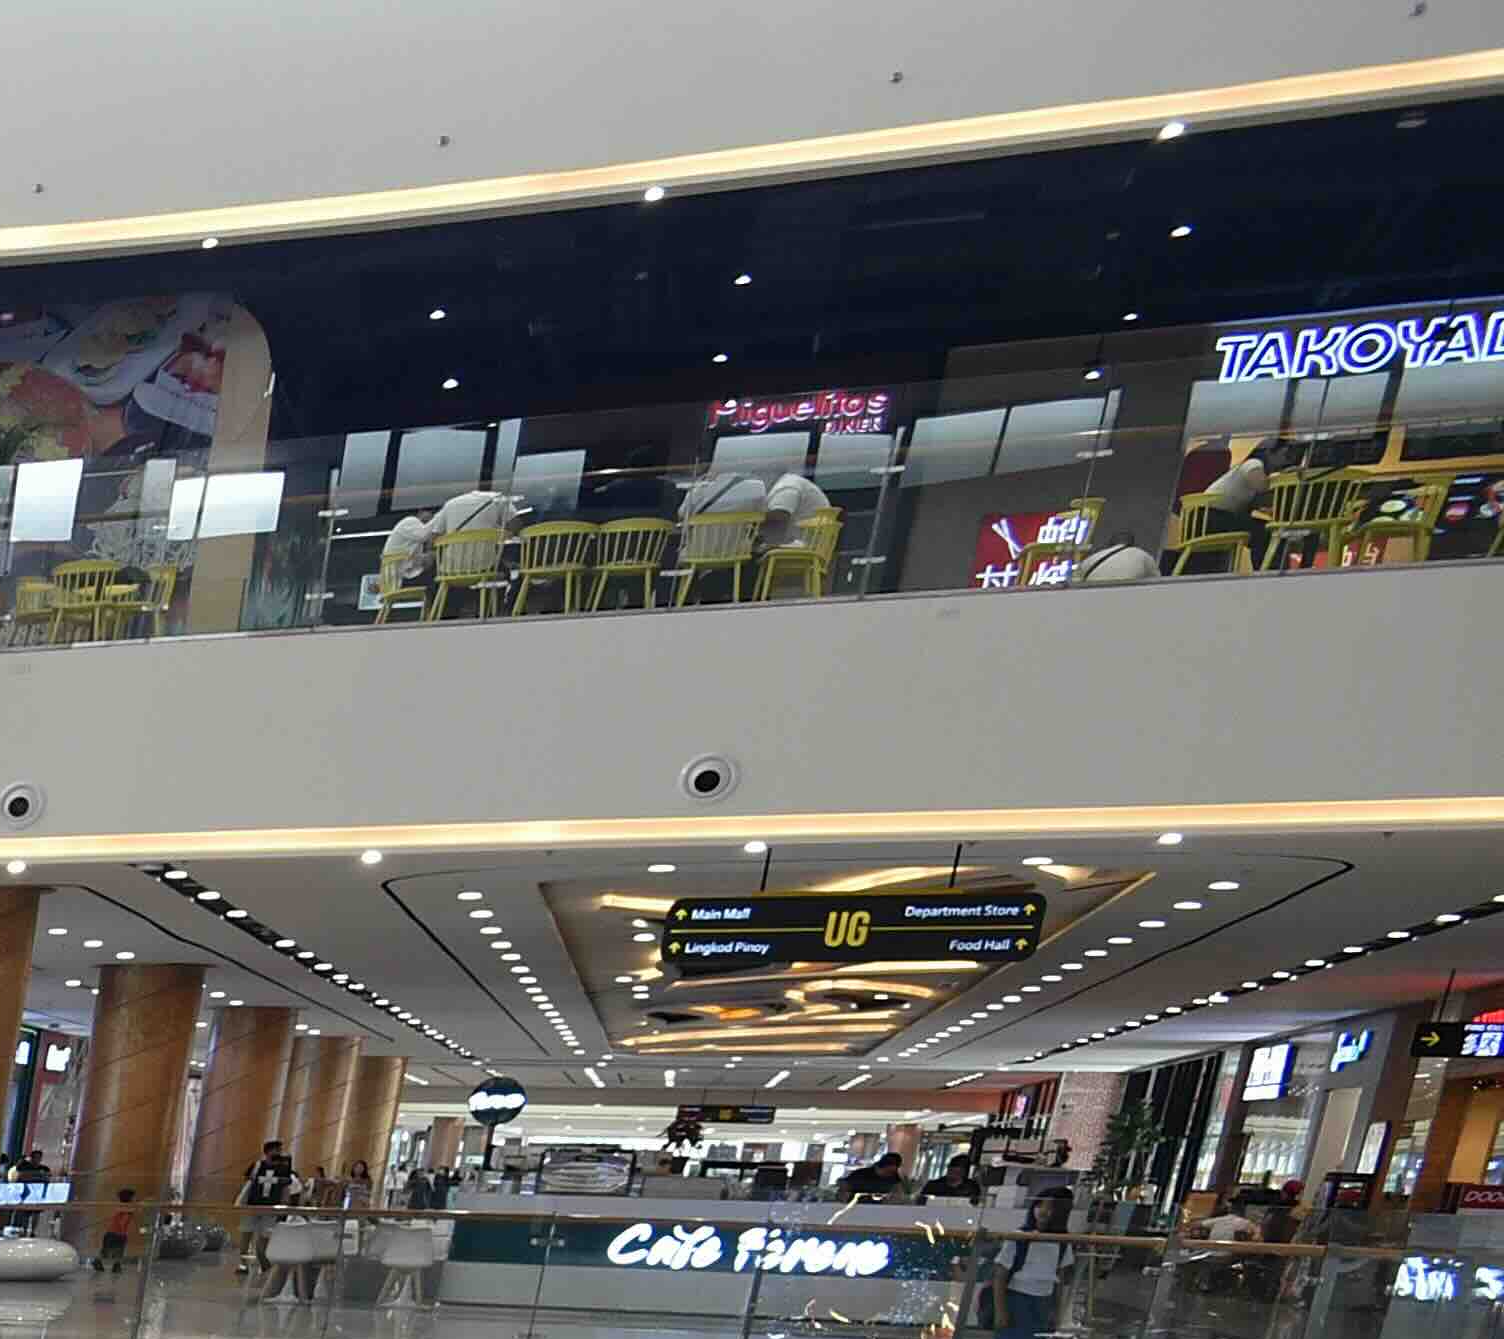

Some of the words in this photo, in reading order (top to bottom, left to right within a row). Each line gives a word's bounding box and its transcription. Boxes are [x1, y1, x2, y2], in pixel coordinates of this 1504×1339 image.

[691, 908, 722, 920] Main
[723, 907, 751, 919] Mall
[903, 904, 981, 919] Department
[983, 904, 1019, 916] Store
[824, 911, 871, 947] UG
[684, 942, 733, 957] Lingkod
[734, 941, 769, 956] Pinoy
[948, 939, 980, 951] Food
[982, 938, 1010, 950] Hall
